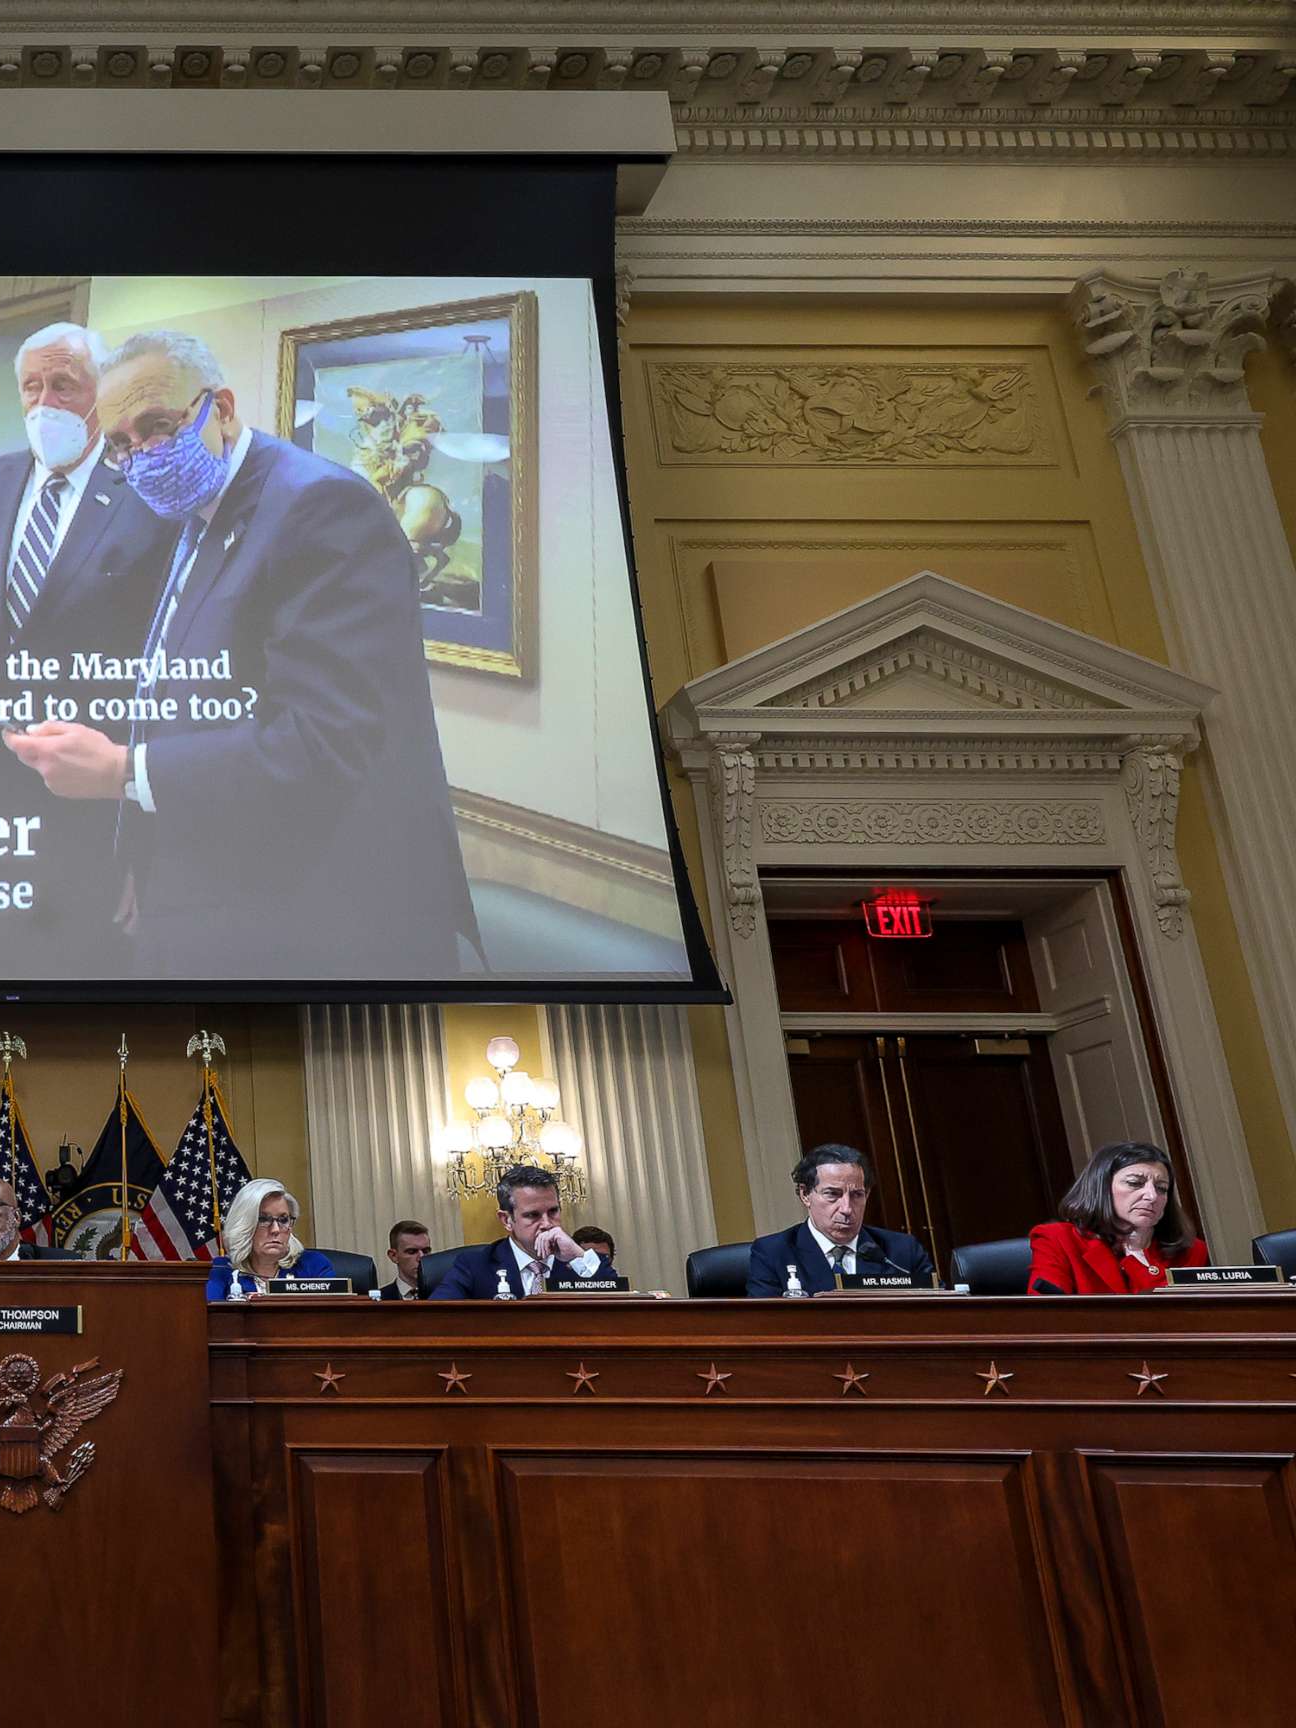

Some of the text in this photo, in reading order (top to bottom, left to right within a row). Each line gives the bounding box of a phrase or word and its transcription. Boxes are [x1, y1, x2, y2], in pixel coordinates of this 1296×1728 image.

[6, 650, 60, 680] the
[69, 650, 232, 688] Maryland
[44, 694, 78, 720] to
[89, 698, 178, 721] come
[188, 687, 258, 720] too?
[876, 906, 922, 935] EXIT
[1196, 1271, 1253, 1281] MRS. LURIA
[558, 1280, 617, 1289] MR. KINZINGER
[863, 1277, 912, 1286] MR. RASKIN
[285, 1283, 331, 1291] MS. CHENEY
[0, 1310, 60, 1320] THOMPSON
